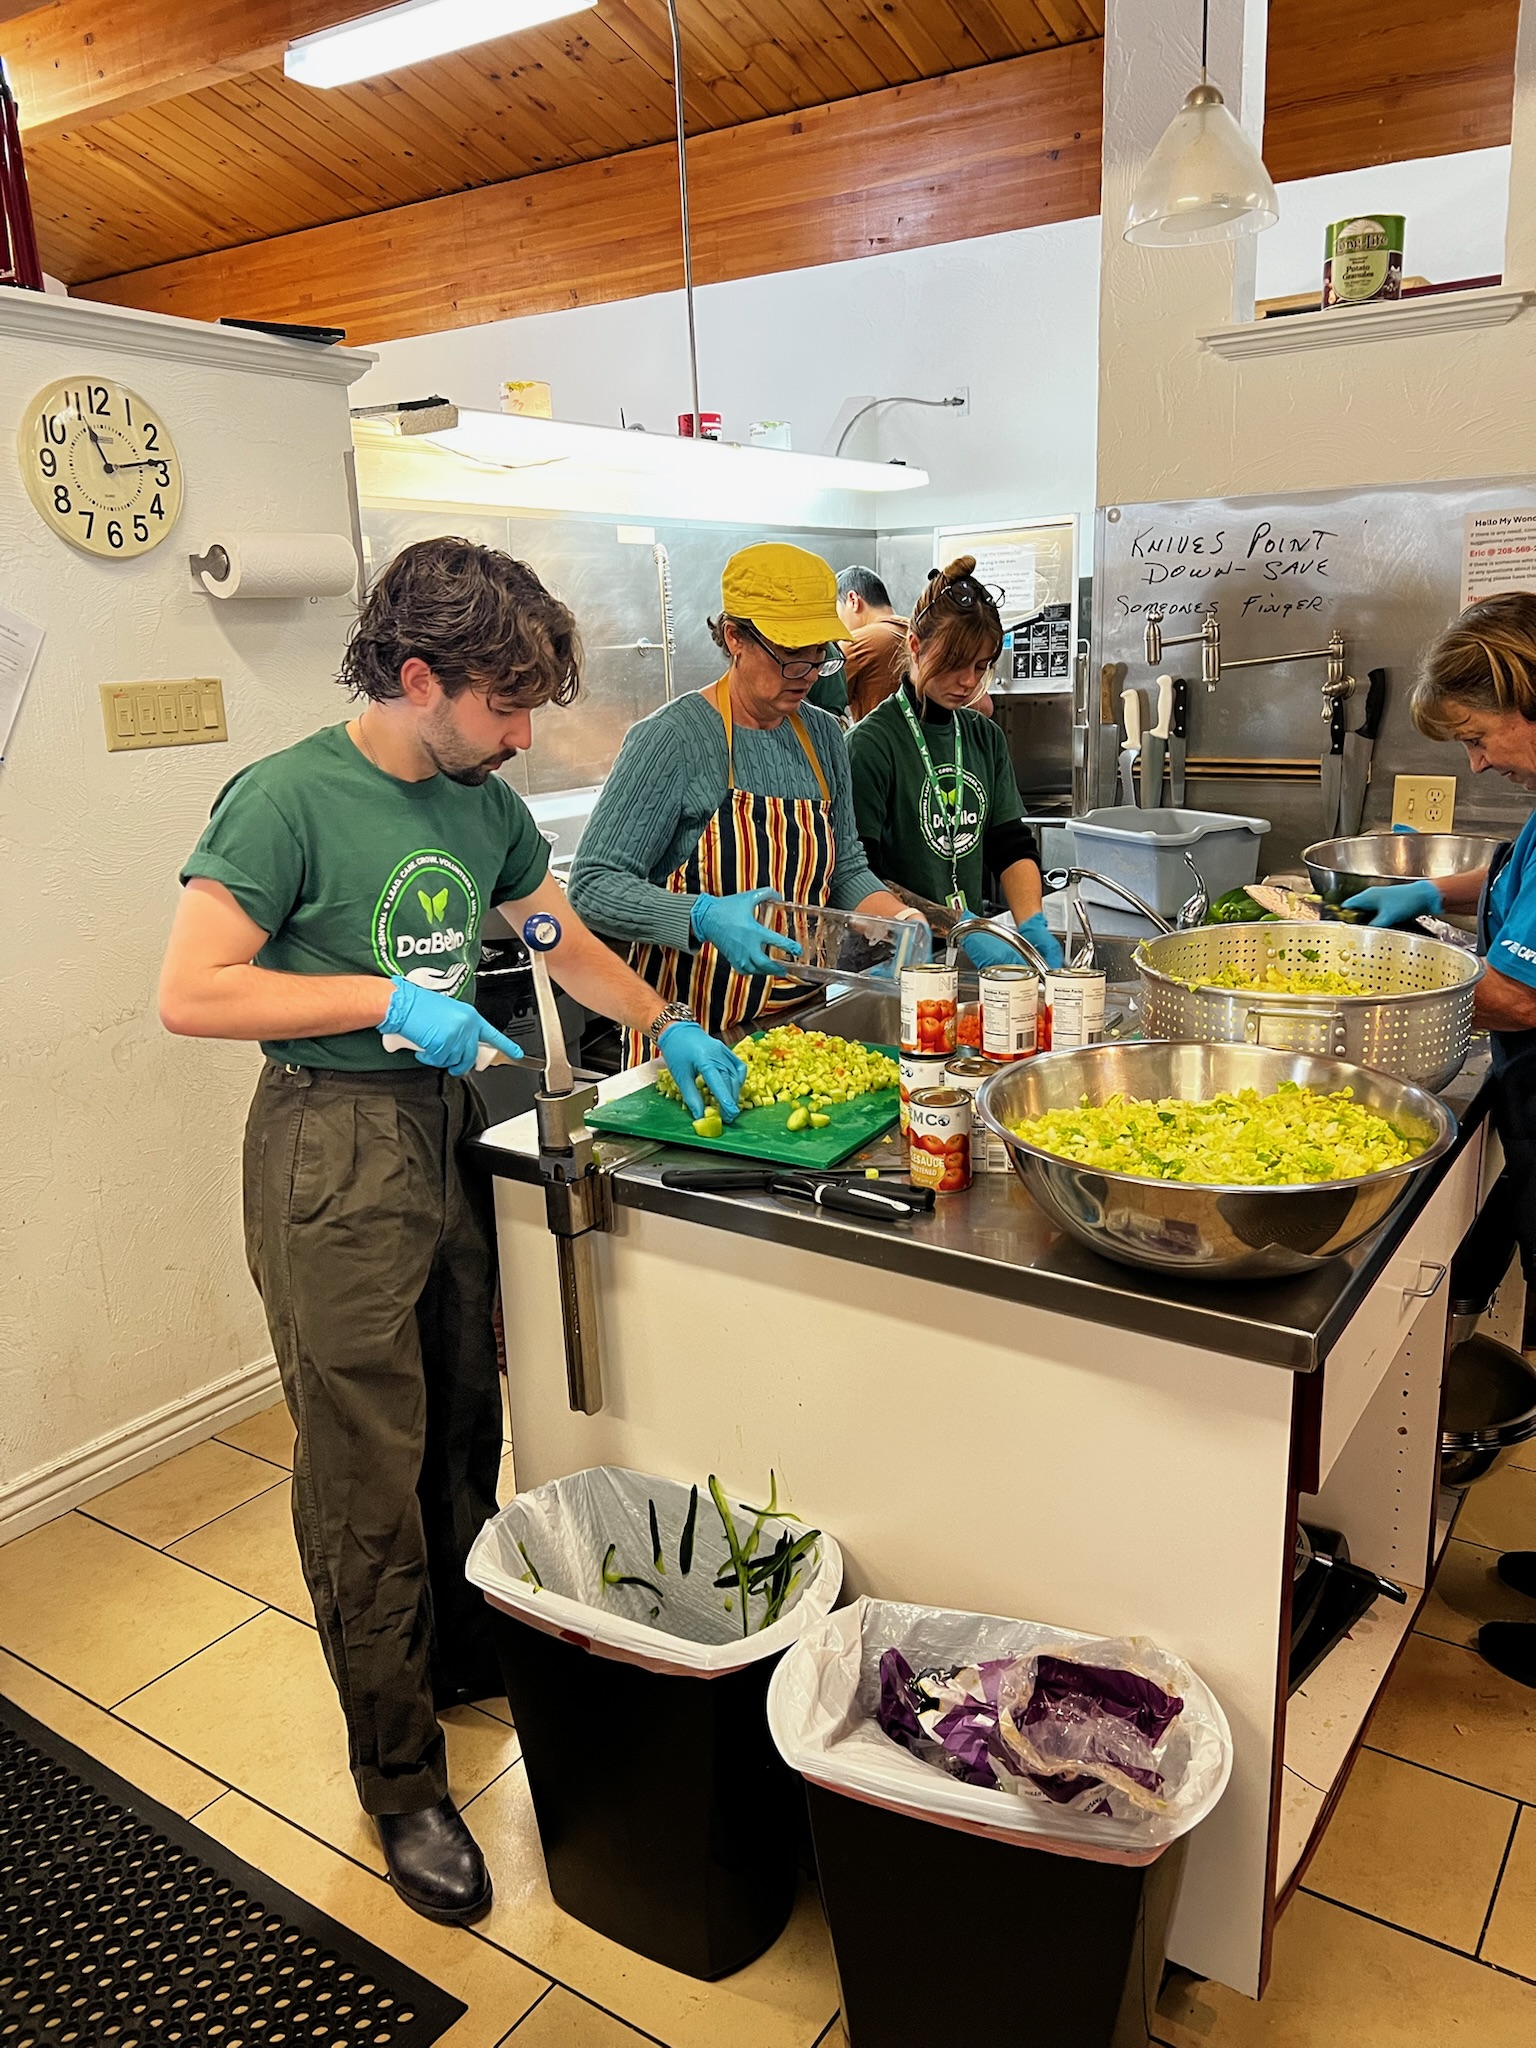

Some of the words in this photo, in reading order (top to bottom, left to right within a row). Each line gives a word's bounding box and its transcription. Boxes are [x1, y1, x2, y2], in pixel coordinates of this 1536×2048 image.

[65, 391, 82, 420] 11
[87, 386, 110, 416] 12
[125, 399, 131, 426] 1
[42, 414, 66, 444] 10
[144, 423, 159, 451] 2
[40, 448, 57, 477] 9
[155, 460, 170, 487] 3
[54, 485, 72, 514] 8
[150, 494, 165, 520] 4
[79, 511, 94, 539] 7
[108, 521, 124, 548] 6
[134, 515, 148, 542] 5
[1131, 526, 1225, 557] KNIVES
[1247, 522, 1338, 559] POINT
[1263, 559, 1330, 580] SAVE
